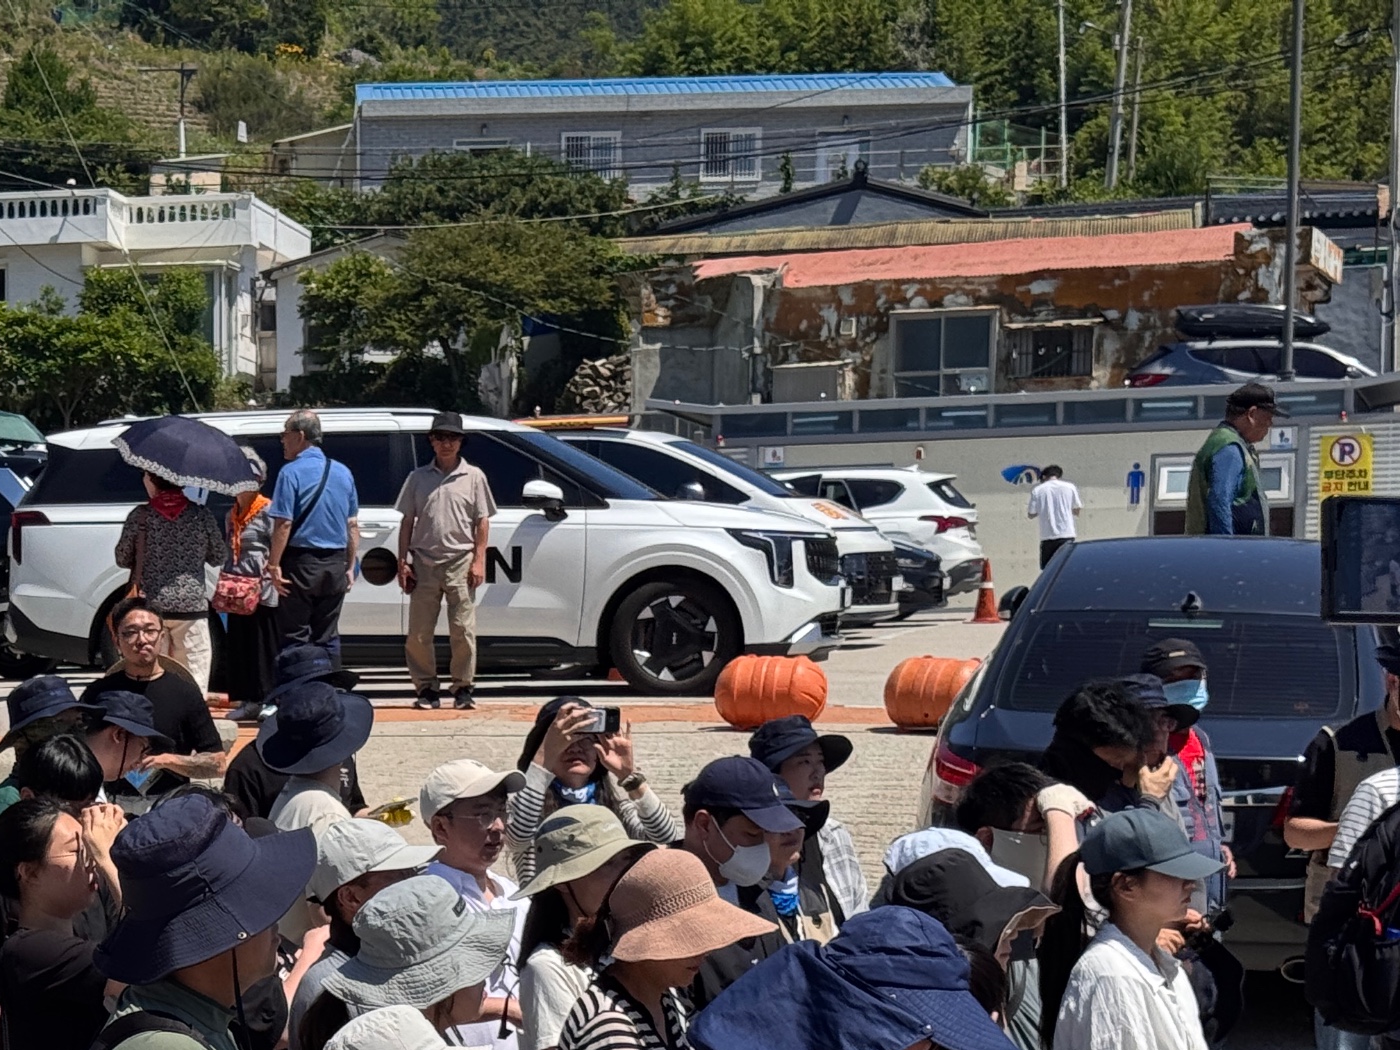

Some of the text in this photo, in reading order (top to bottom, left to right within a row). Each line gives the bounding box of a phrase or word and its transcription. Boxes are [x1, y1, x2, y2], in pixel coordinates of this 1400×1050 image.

[1324, 469, 1368, 480] 무단주차
[1322, 481, 1369, 492] 금지 안내
